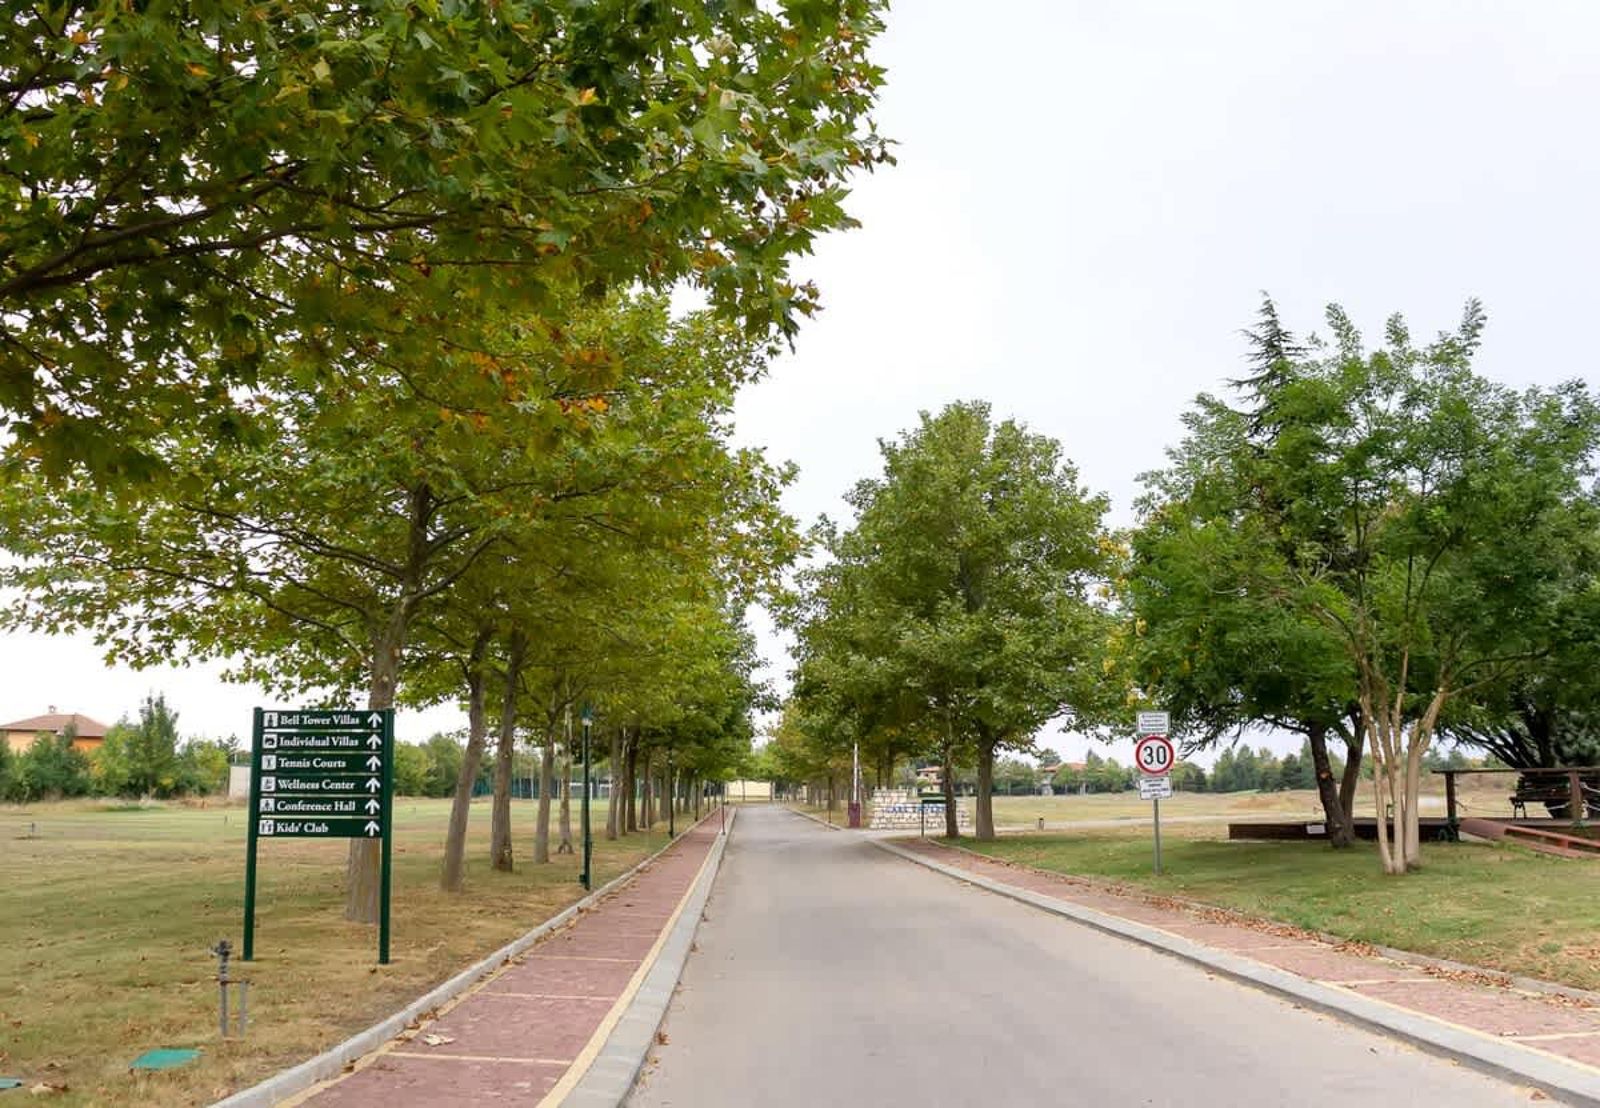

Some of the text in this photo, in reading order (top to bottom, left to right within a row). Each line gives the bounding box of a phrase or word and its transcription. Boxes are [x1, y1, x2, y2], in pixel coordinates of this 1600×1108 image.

[280, 715, 359, 725] Bell Tower Villas
[279, 737, 359, 746] Individual Villas
[1143, 745, 1167, 765] 30
[278, 758, 346, 768] Tennis Courts
[277, 780, 355, 790] Wellness Center
[277, 801, 356, 811] Conference Hall
[276, 822, 329, 833] Kids' Club
